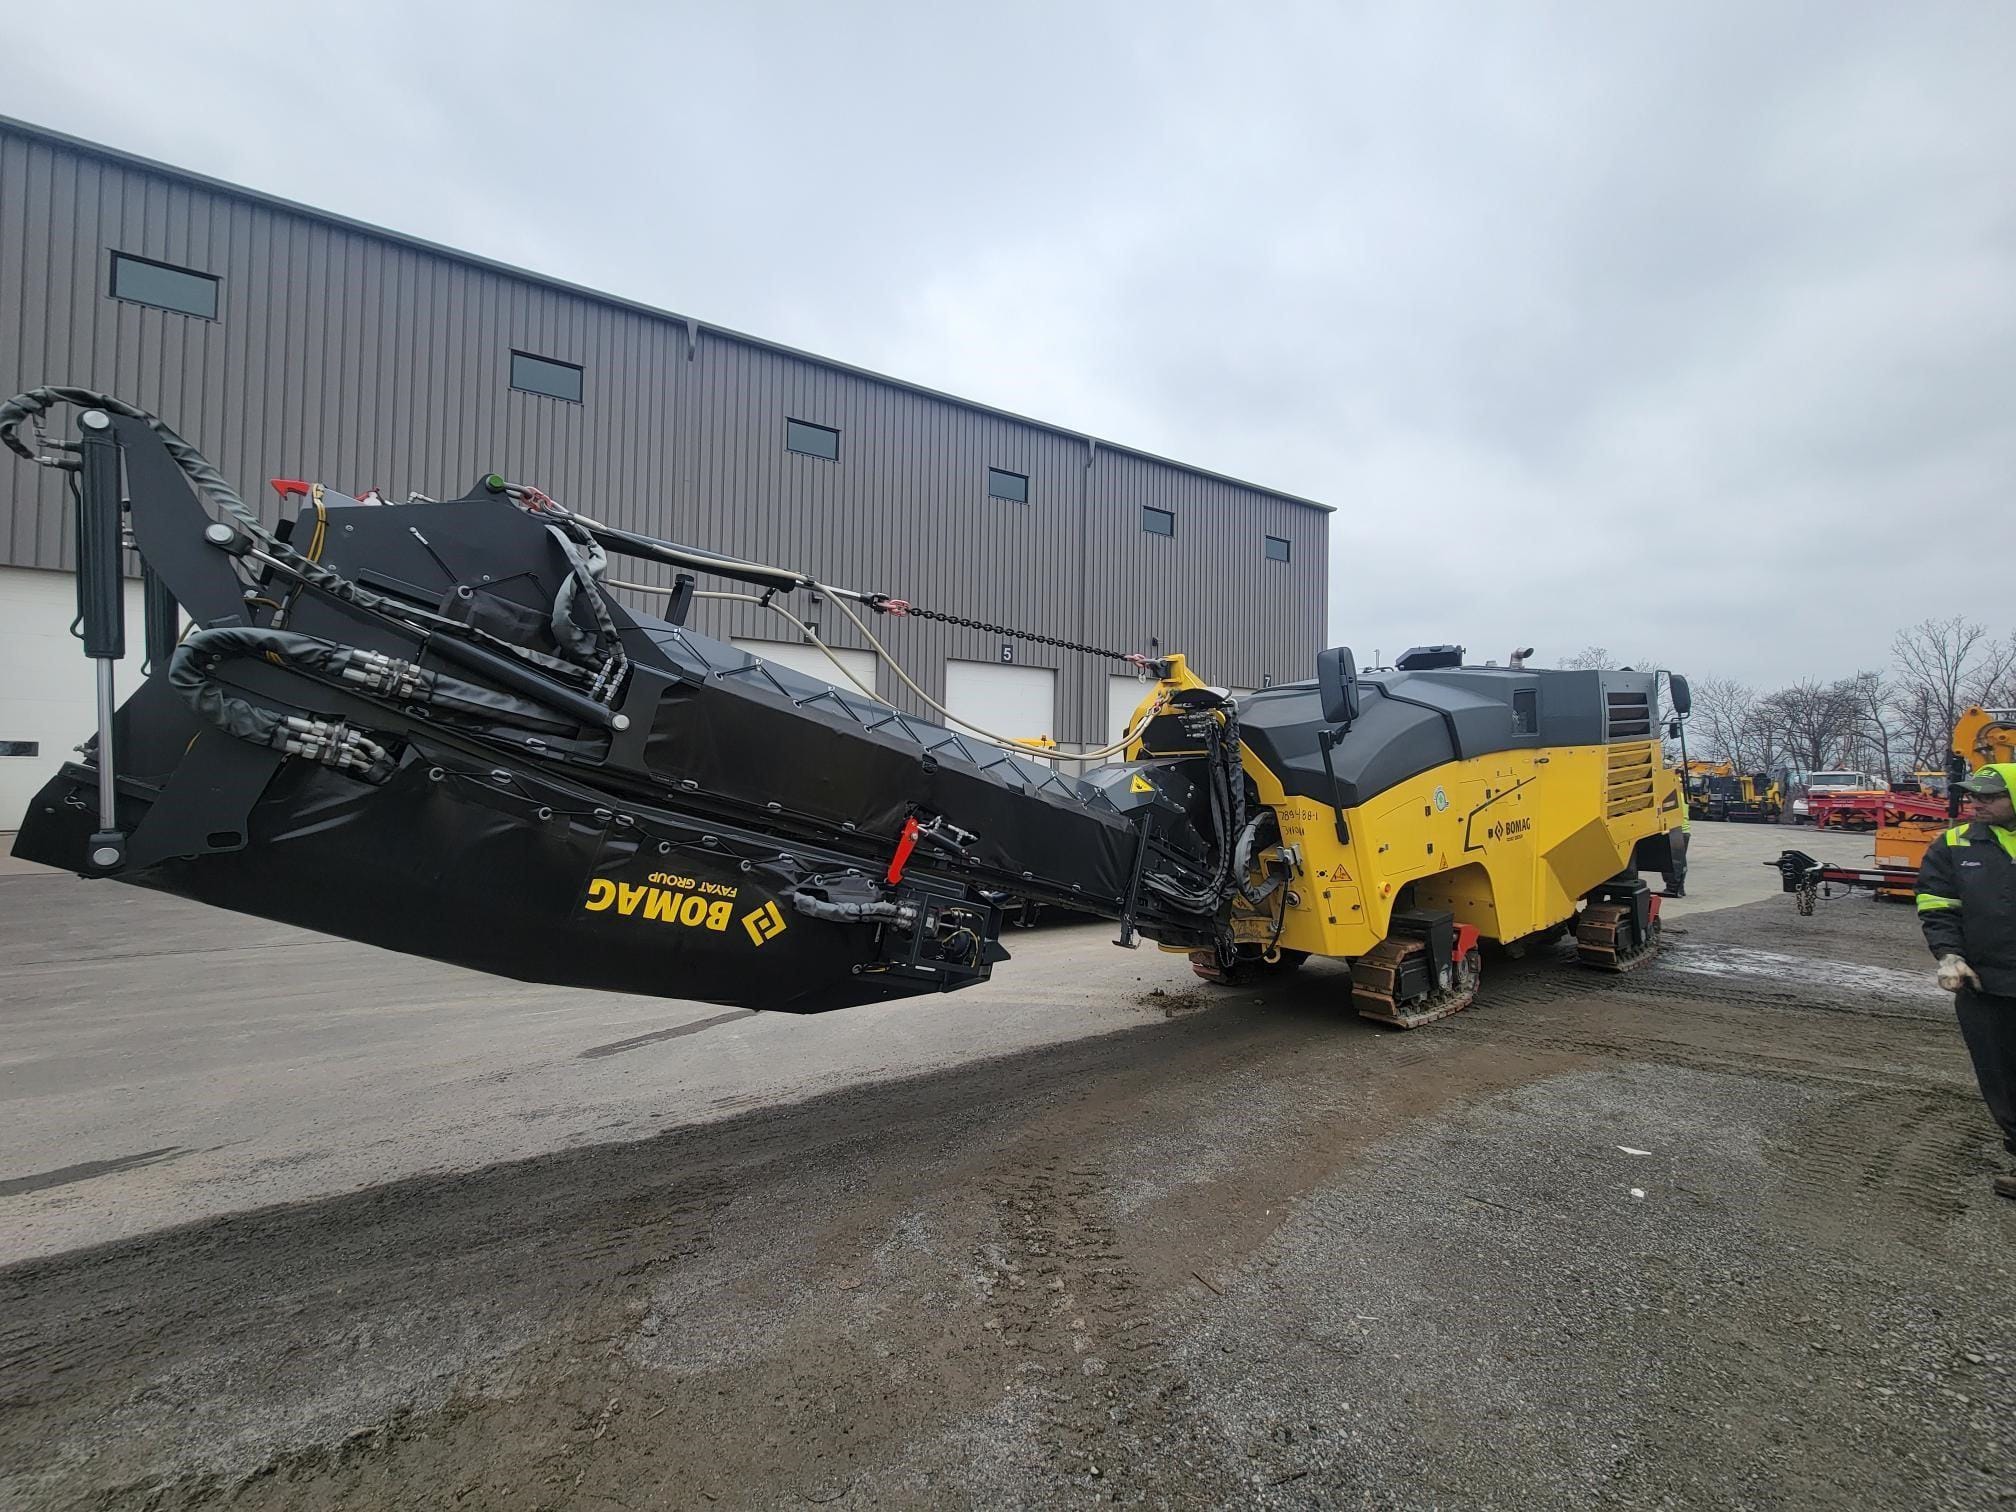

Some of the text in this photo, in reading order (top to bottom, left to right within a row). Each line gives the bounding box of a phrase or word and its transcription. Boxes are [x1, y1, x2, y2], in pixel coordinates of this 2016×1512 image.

[1004, 647, 1011, 660] 5
[1265, 677, 1271, 687] 7
[1505, 817, 1531, 836] BOMAG
[648, 871, 738, 898] FAYAT GROUP
[585, 878, 733, 932] BOMAG
